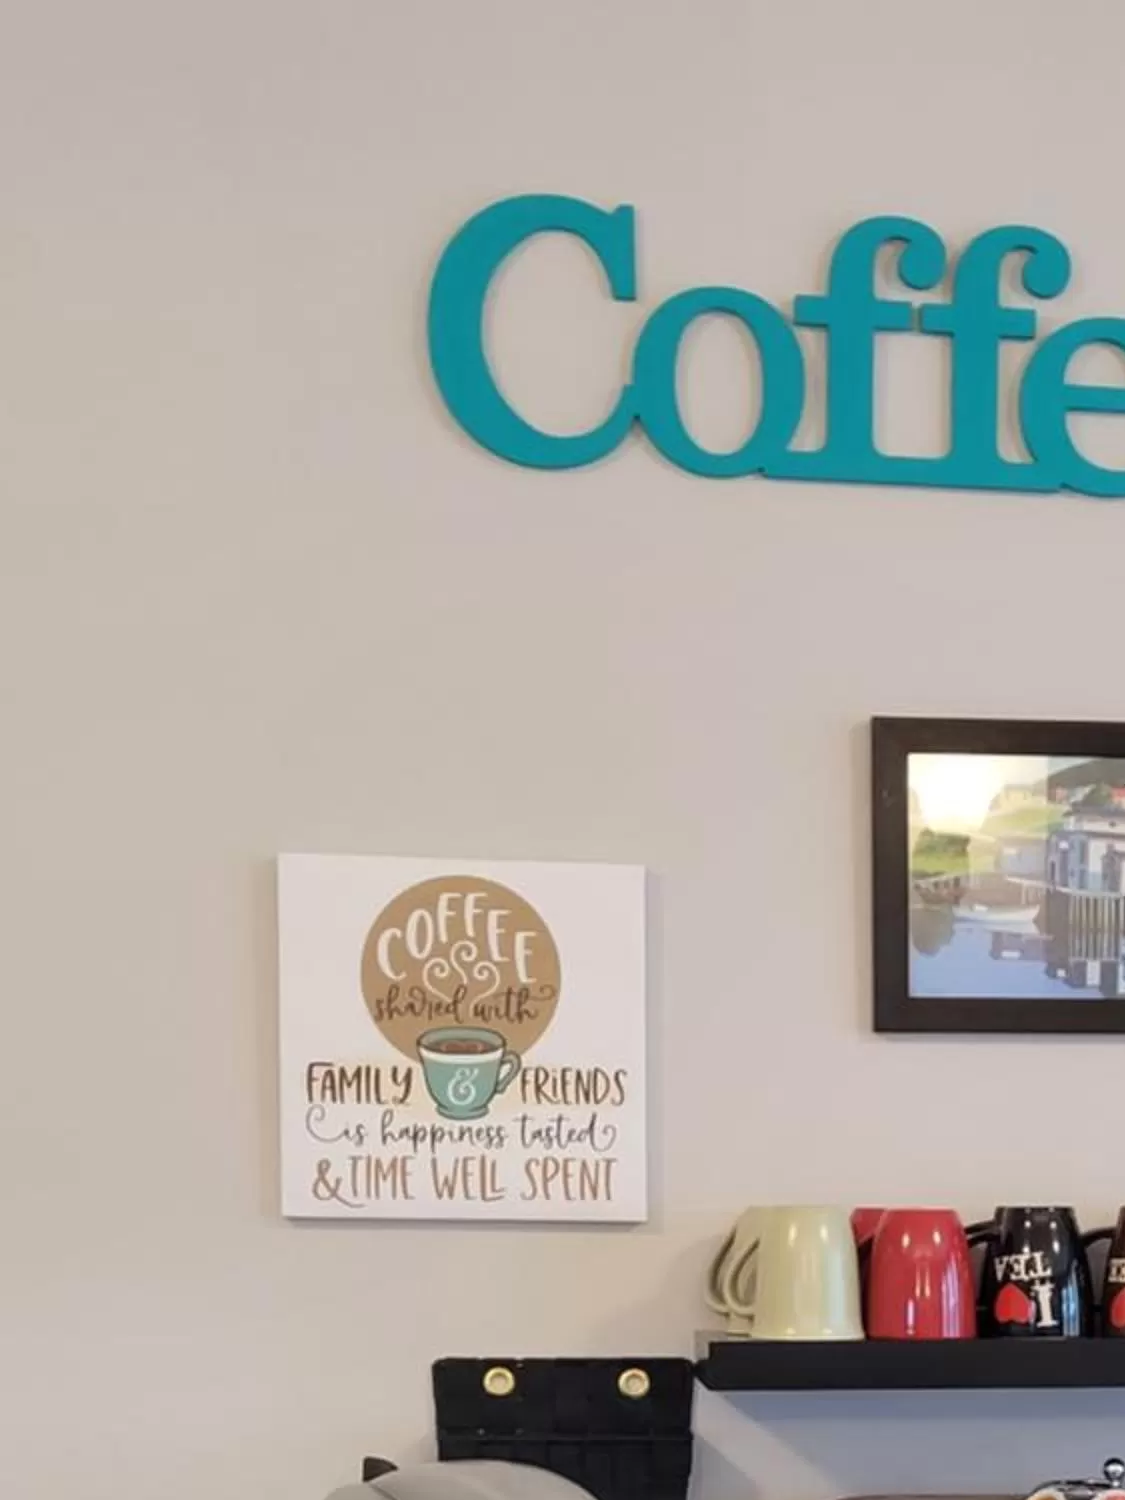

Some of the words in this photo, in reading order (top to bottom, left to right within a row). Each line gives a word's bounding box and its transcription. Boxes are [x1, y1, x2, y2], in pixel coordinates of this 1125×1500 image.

[377, 891, 537, 984] COFFEE
[373, 983, 466, 1024] shared
[473, 984, 557, 1023] with
[306, 1061, 414, 1106] FAMILY
[447, 1067, 480, 1106] &
[381, 1109, 507, 1151] happiness
[513, 1111, 617, 1151] tasted
[431, 1154, 506, 1202] WELL
[521, 1156, 618, 1202] SPENT
[994, 1251, 1053, 1281] TEA
[1032, 1282, 1058, 1328] I
